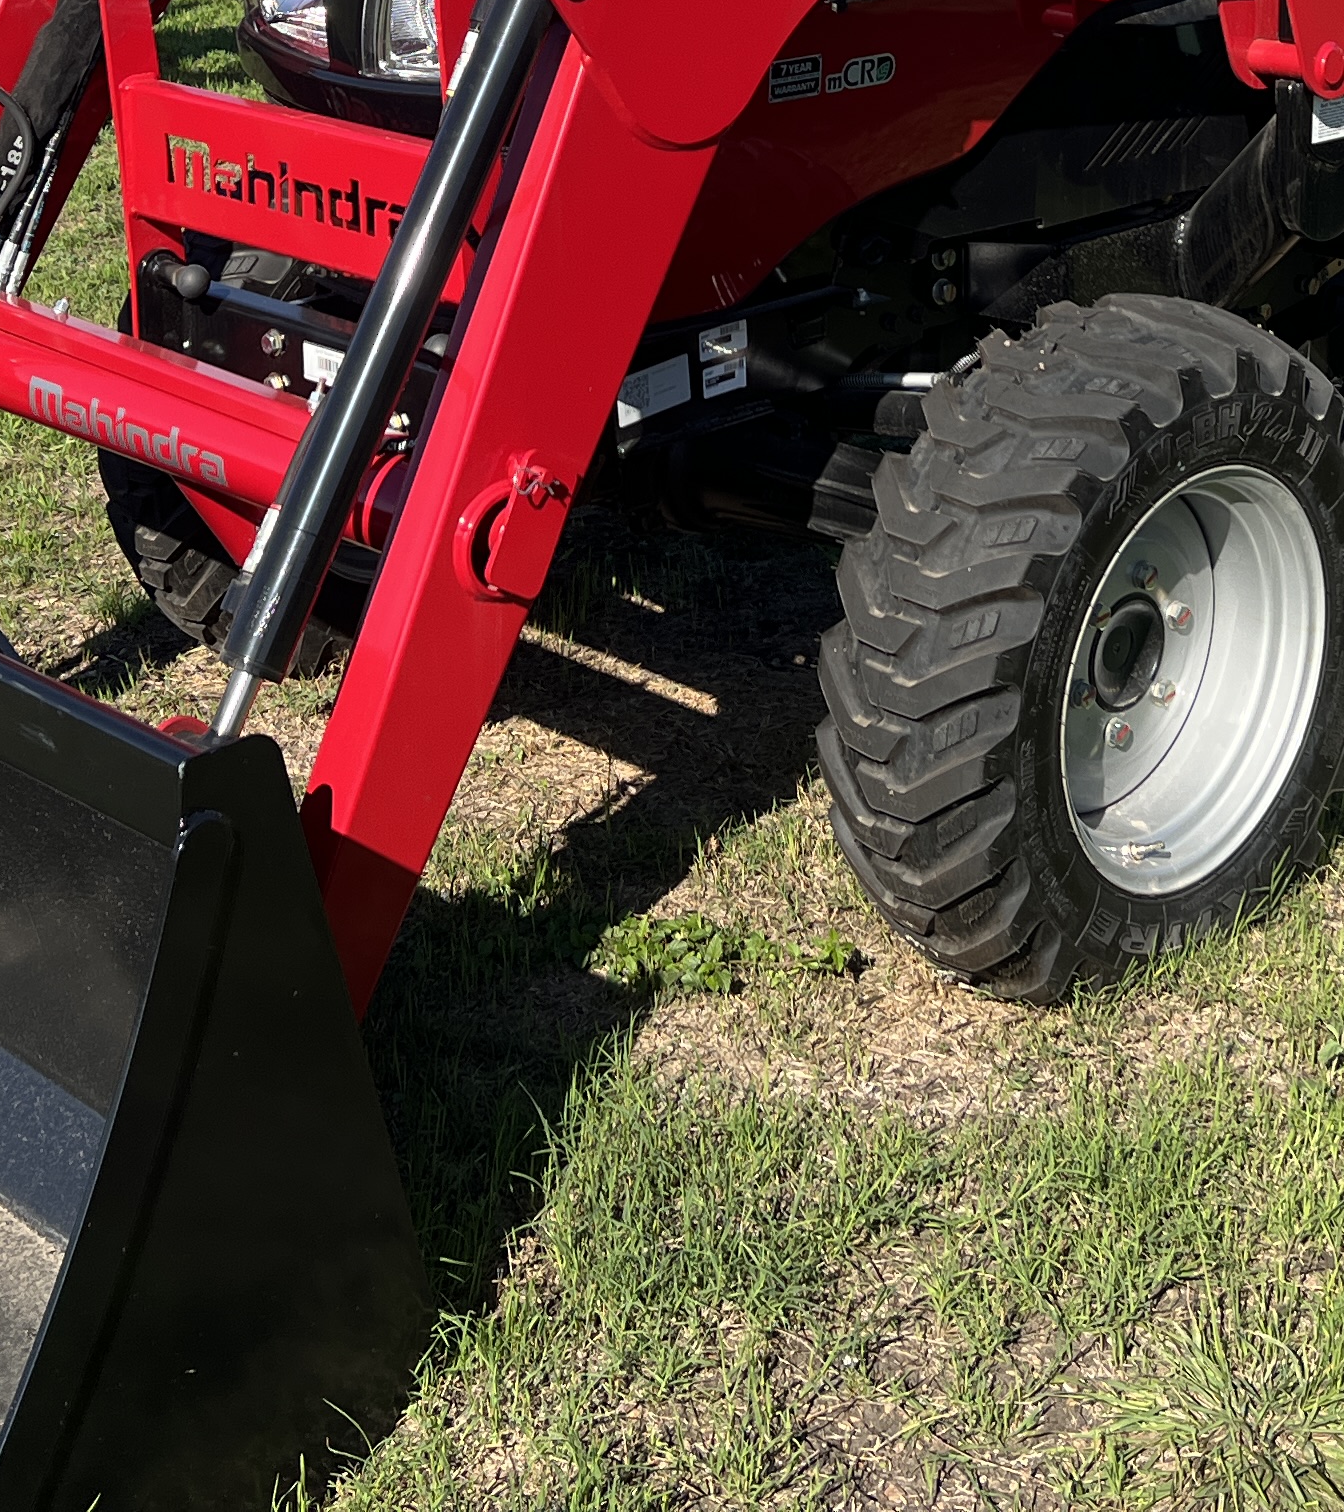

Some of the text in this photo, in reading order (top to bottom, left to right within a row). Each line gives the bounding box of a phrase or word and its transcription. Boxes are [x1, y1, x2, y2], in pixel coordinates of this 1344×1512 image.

[780, 62, 812, 76] 7 YEAR
[774, 80, 816, 95] WARRANTY
[28, 375, 230, 488] Mahindra
